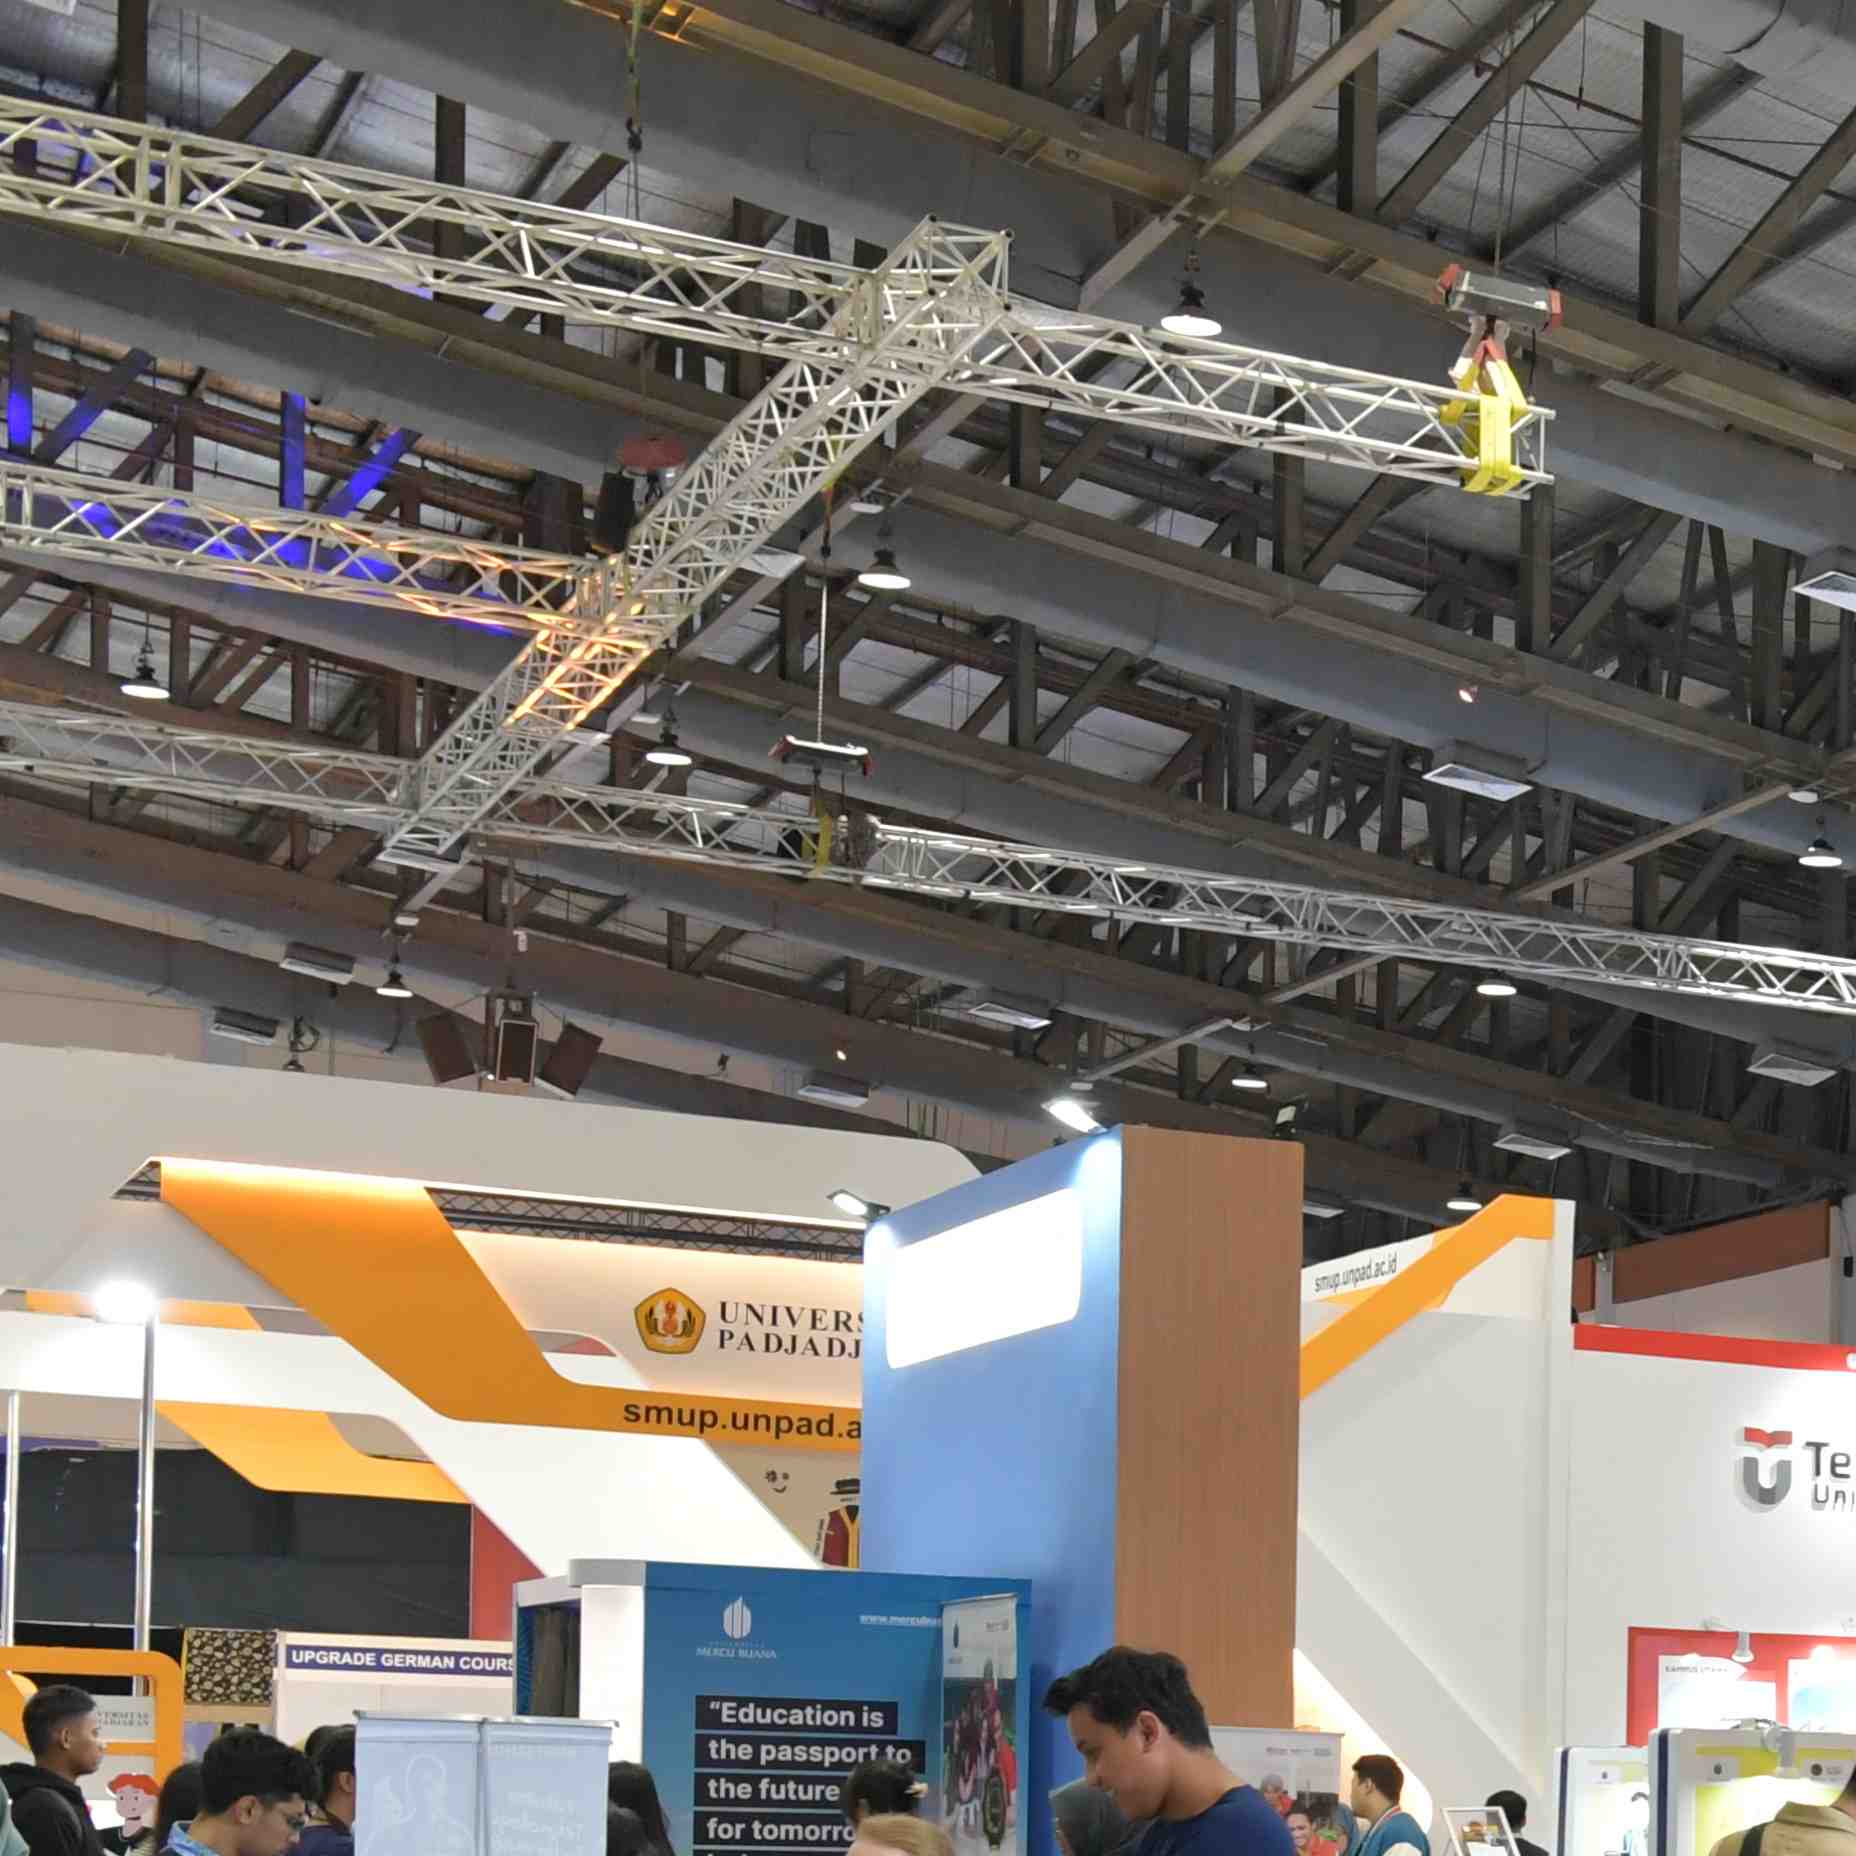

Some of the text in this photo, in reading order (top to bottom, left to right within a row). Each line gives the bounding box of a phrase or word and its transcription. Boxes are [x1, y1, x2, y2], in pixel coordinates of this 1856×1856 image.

[1314, 1252, 1398, 1292] smup.unpad.ac.id
[291, 1649, 377, 1667] UPGRADE
[380, 1652, 456, 1670] GERMAN
[862, 1705, 885, 1728] is
[708, 1738, 912, 1767] the passport to
[707, 1778, 840, 1801] the future
[706, 1818, 746, 1840] for
